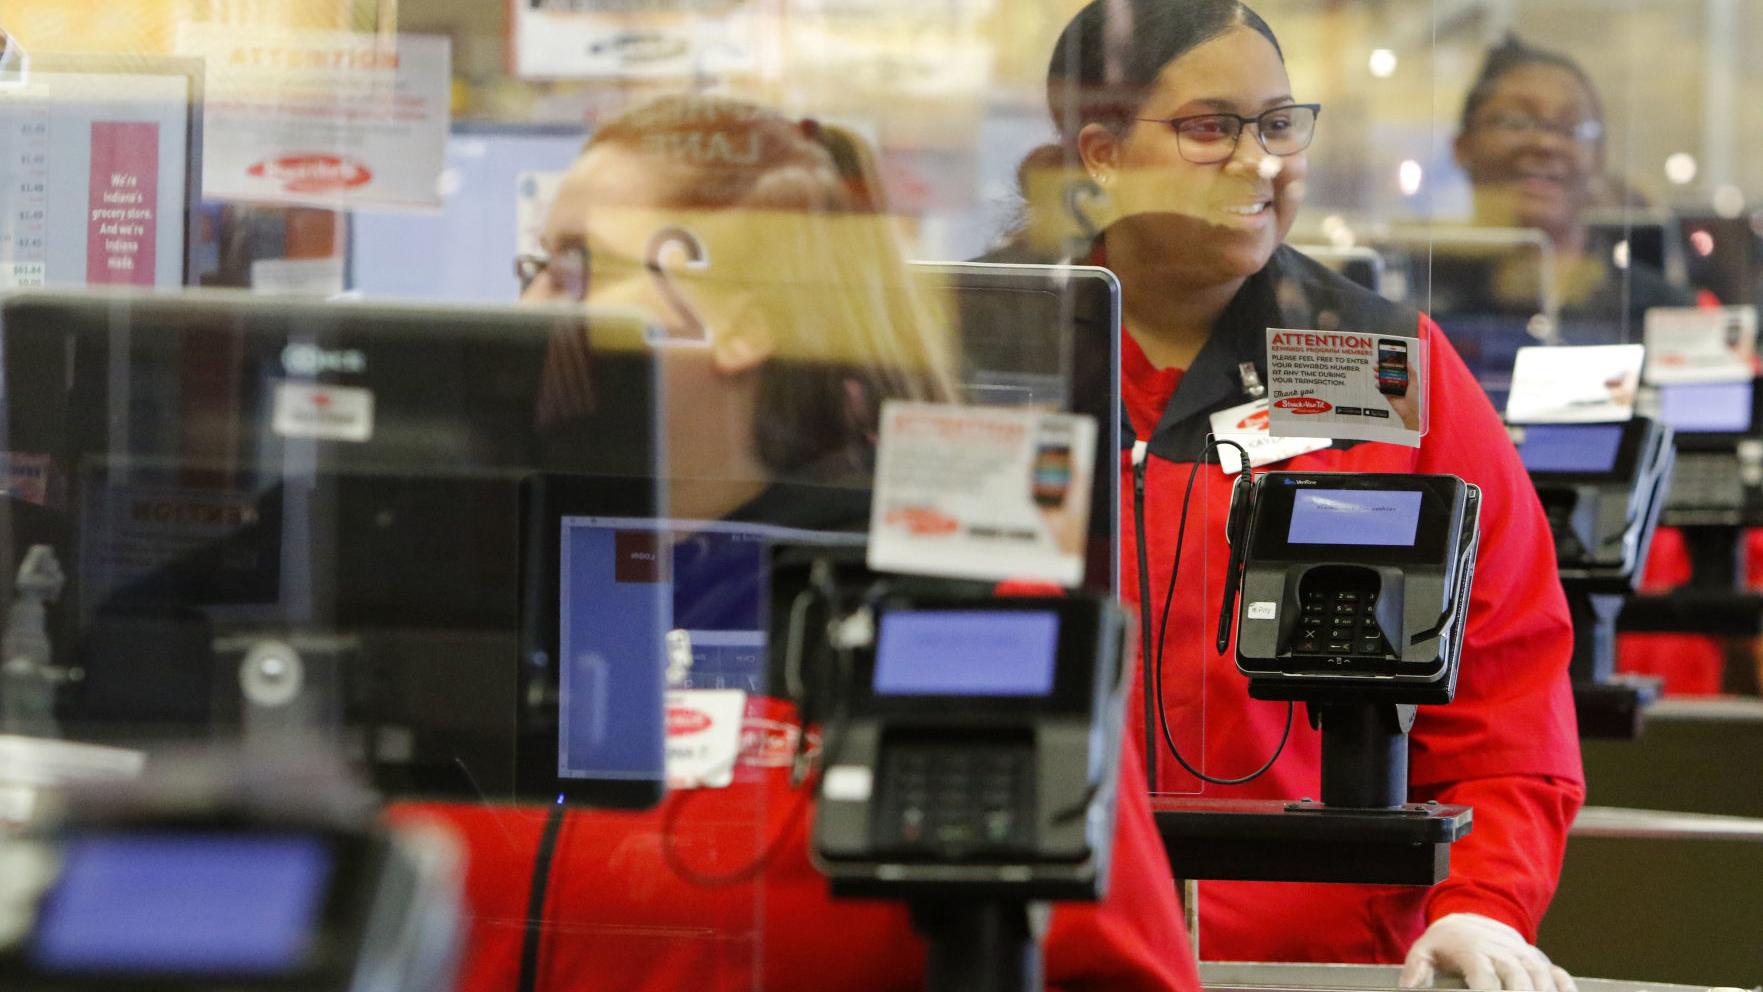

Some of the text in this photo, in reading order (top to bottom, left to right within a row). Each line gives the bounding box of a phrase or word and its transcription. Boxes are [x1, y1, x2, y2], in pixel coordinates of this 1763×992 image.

[111, 173, 137, 187] We're
[103, 191, 144, 203] Indiana's
[92, 208, 126, 221] grocery
[99, 223, 144, 236] And we're
[105, 239, 139, 253] Indiana
[1272, 333, 1373, 349] ATTENTION
[1273, 388, 1315, 398] Thank you
[1258, 606, 1272, 615] Pay
